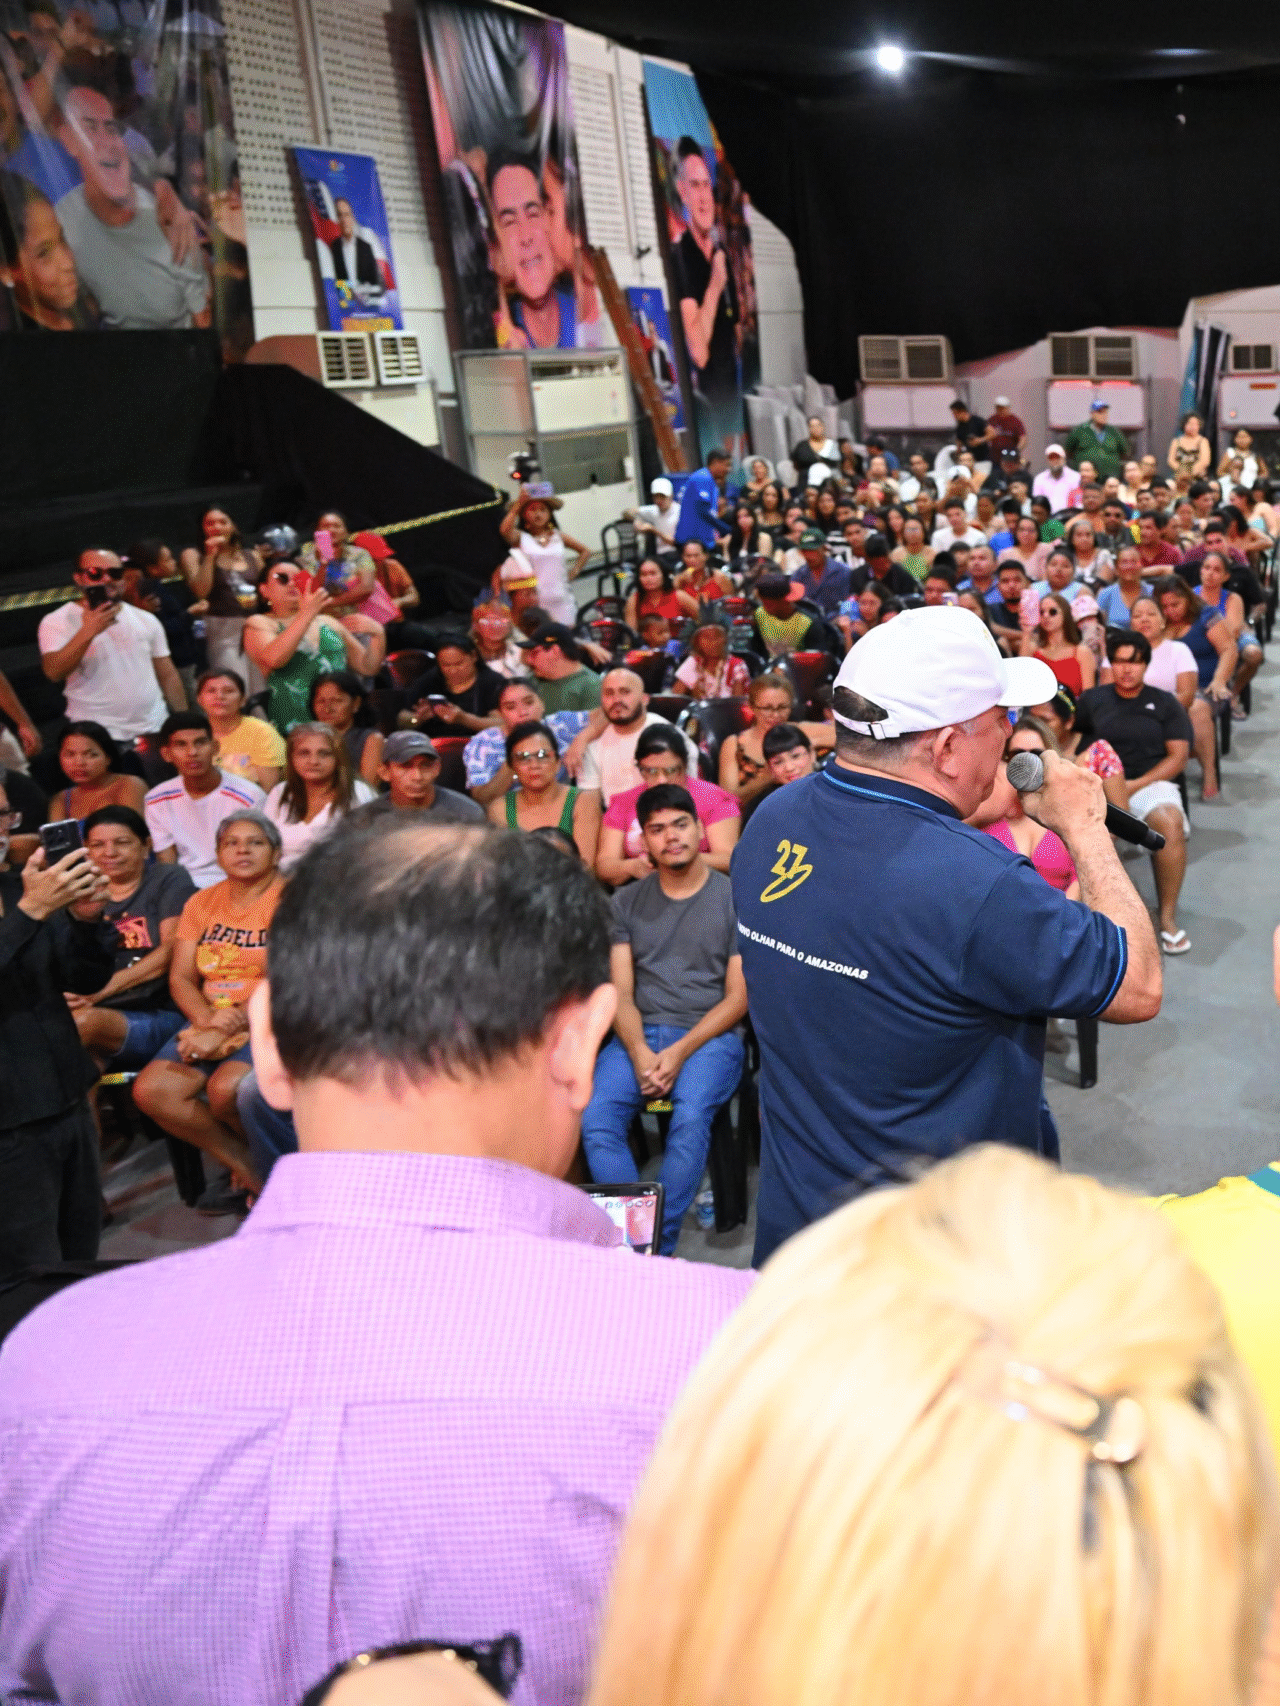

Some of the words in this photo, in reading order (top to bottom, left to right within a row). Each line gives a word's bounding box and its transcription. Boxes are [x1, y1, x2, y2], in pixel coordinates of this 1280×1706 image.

[750, 931, 776, 949] OLHAR
[775, 941, 796, 959] PARA
[796, 951, 805, 961] O
[804, 955, 869, 980] AMAZONAS
